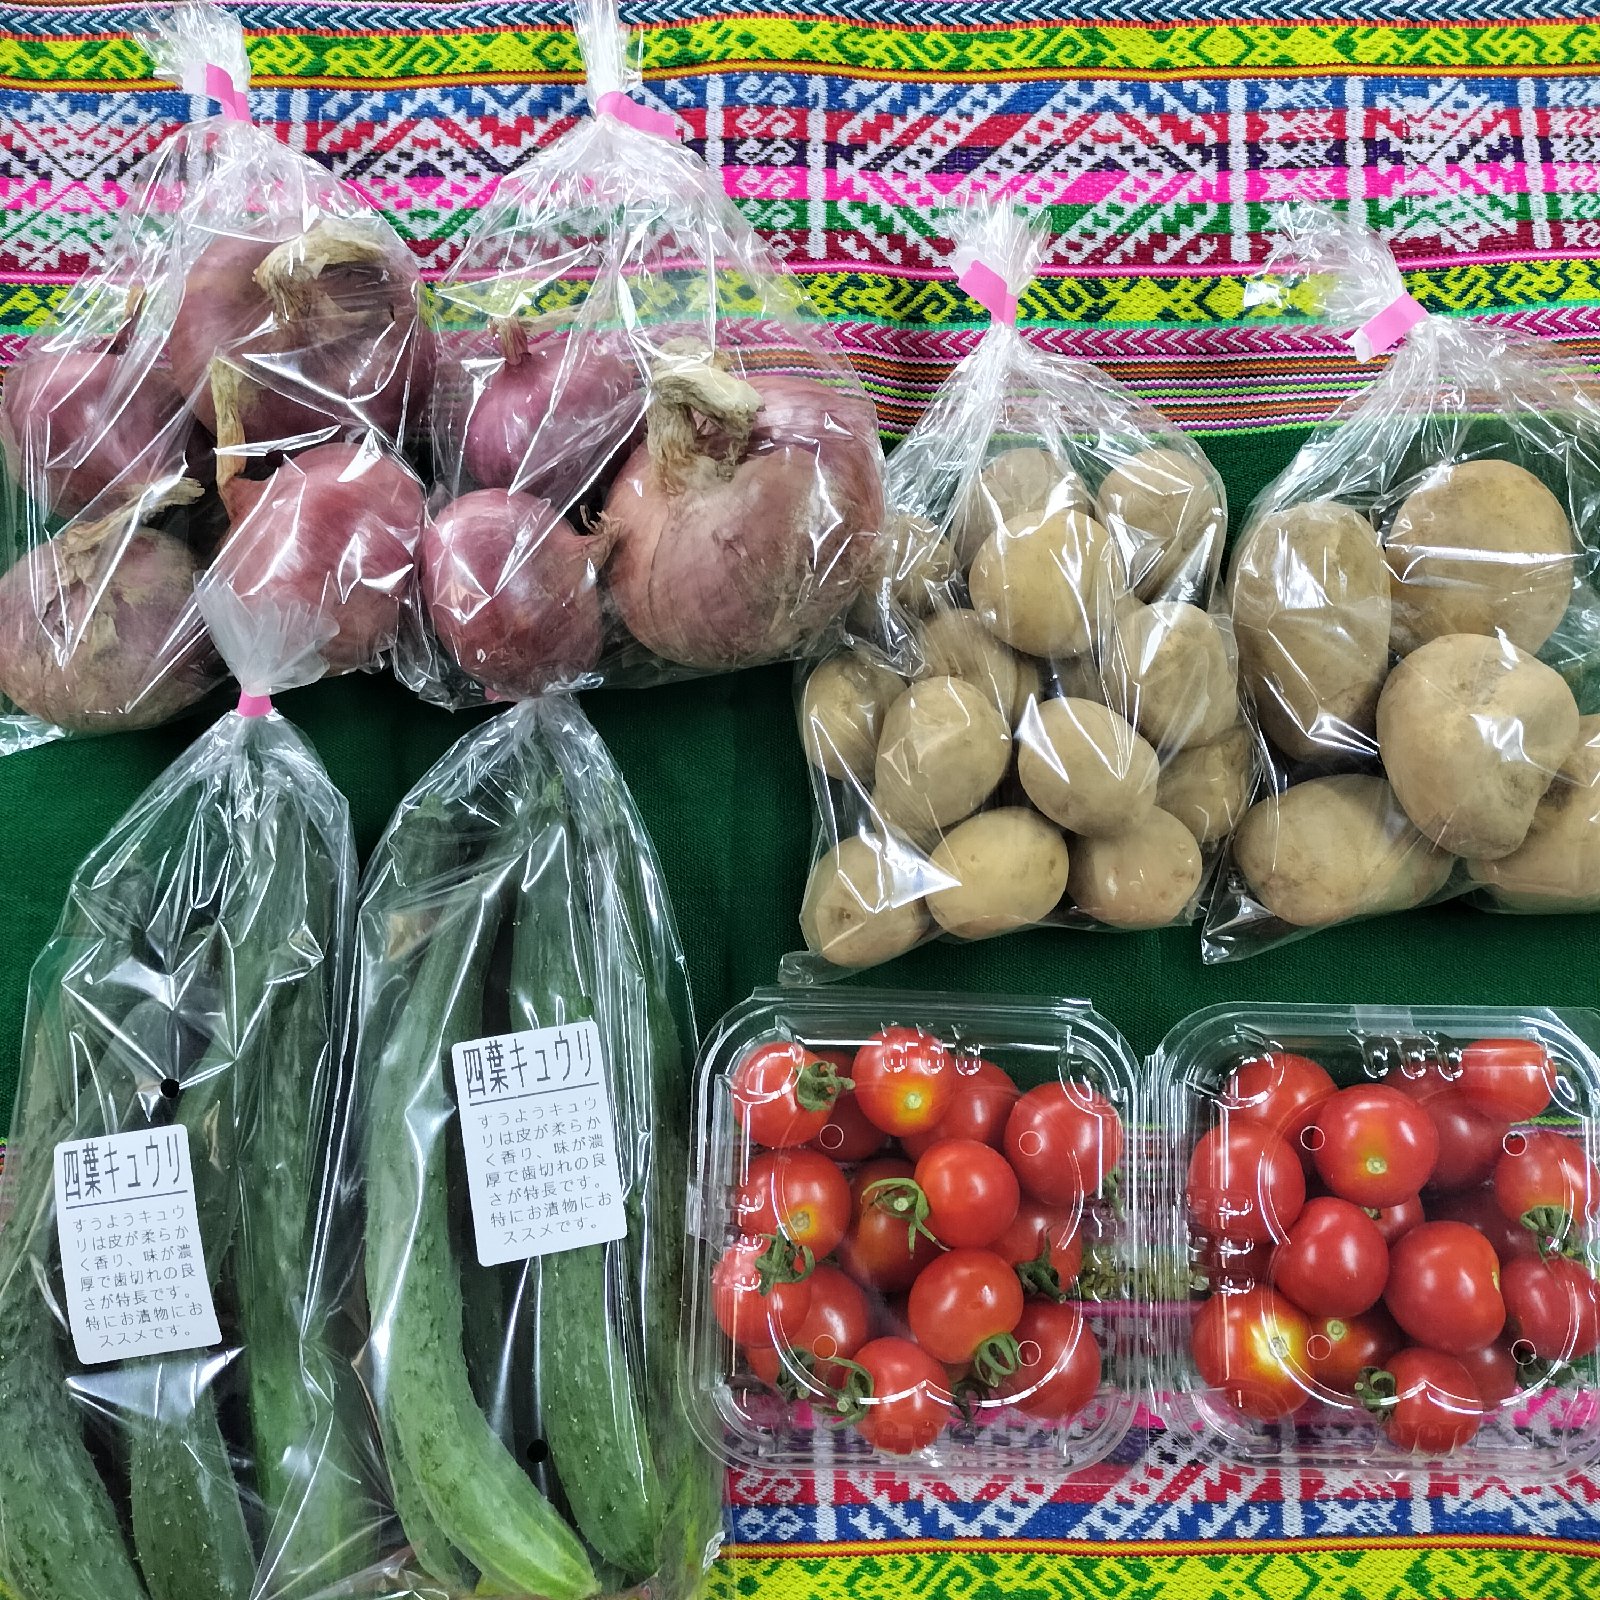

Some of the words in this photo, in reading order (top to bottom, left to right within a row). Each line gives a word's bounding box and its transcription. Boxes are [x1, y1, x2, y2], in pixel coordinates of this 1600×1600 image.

[462, 1028, 592, 1098] 四葉キュウリ
[477, 1096, 598, 1129] すうようキュウ
[482, 1115, 602, 1149] リは皮が柔らか
[485, 1133, 605, 1167] く香り、味が濃
[63, 1132, 181, 1202] 四葉キュウリ
[485, 1152, 607, 1188] 厚で歯切れの良
[489, 1174, 601, 1206] さが特長です。
[74, 1204, 186, 1233] すうようキュウ
[490, 1191, 612, 1228] 特にお漬物にお
[76, 1224, 190, 1254] リは皮が柔らか
[503, 1215, 598, 1245] ススメです。
[80, 1243, 194, 1272] く香り、味が濃
[80, 1262, 196, 1293] 厚で歯切れの良
[84, 1284, 192, 1311] さが特長です。
[85, 1301, 204, 1332] 特にお漬物にお
[99, 1325, 191, 1349] ススメです。
